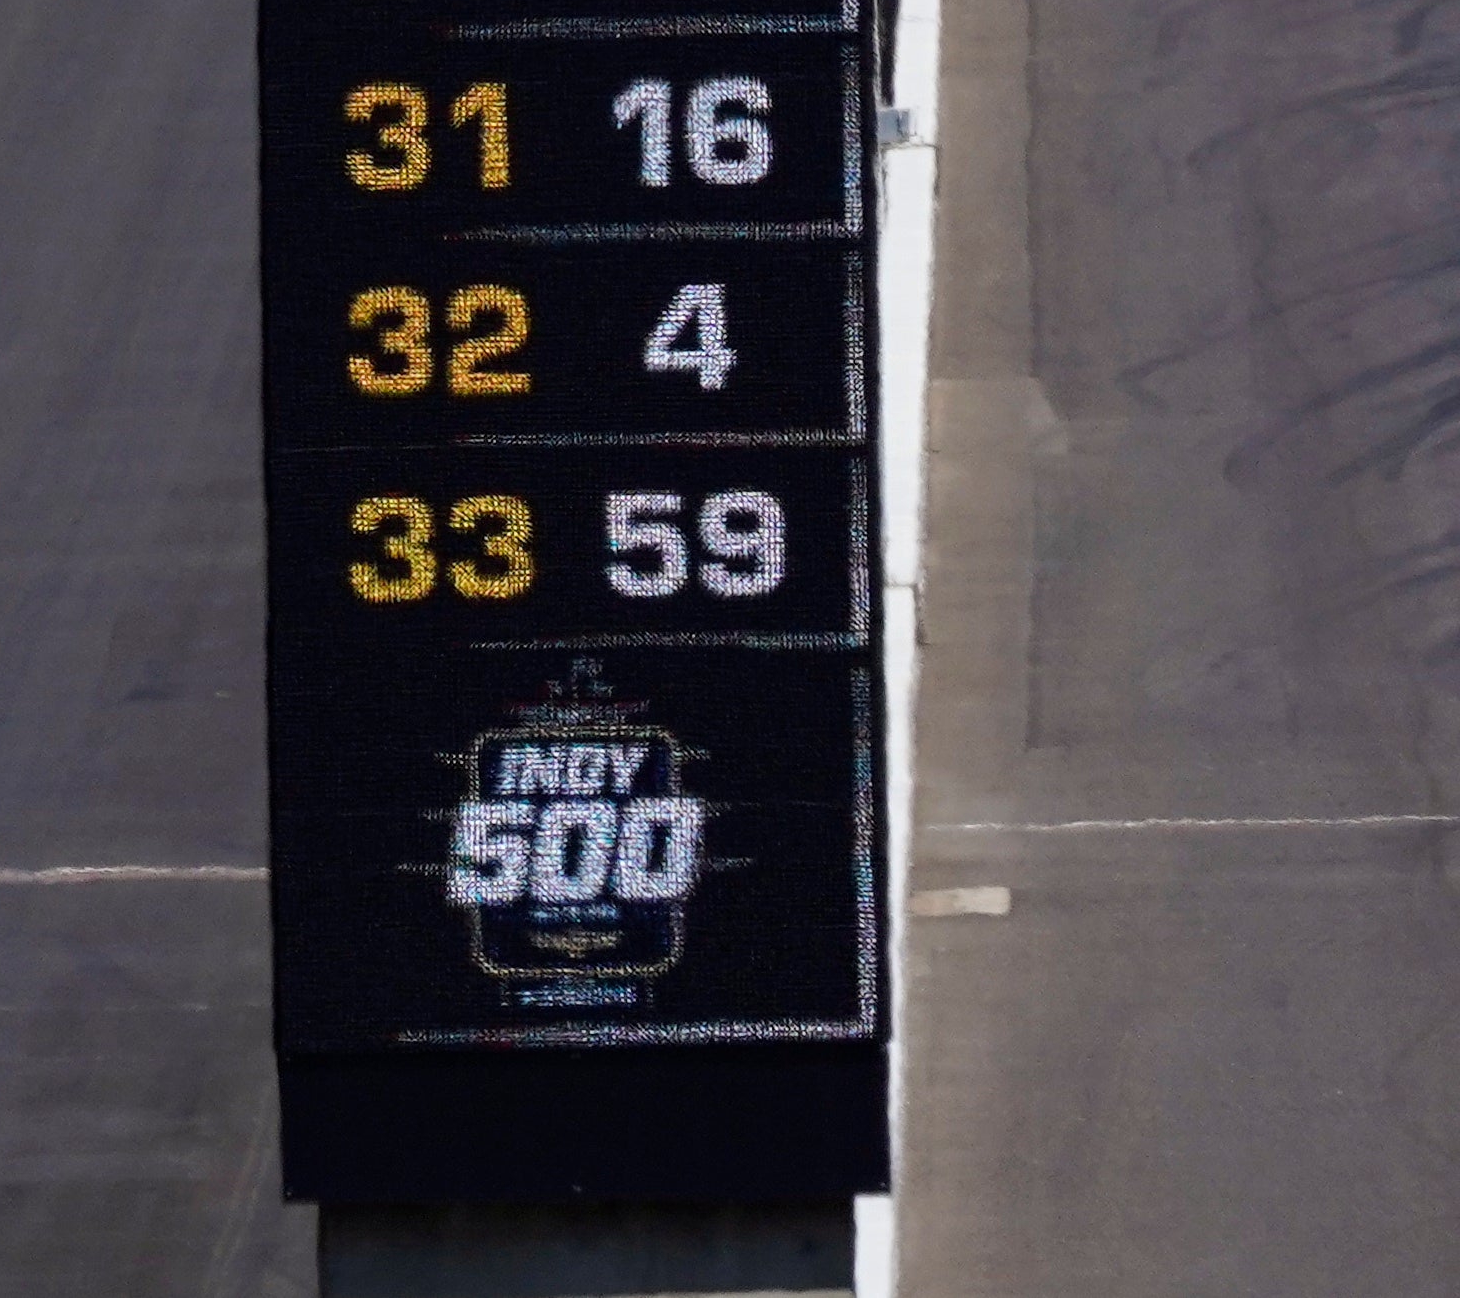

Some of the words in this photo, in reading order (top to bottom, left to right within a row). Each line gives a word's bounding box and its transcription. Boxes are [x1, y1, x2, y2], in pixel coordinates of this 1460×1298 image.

[342, 79, 511, 192] 31
[607, 72, 775, 189] 16
[343, 281, 531, 396] 32
[639, 279, 738, 392] 4
[345, 491, 535, 604] 33
[601, 486, 787, 600] 59
[492, 741, 652, 796] INDY
[446, 796, 707, 905] 500
